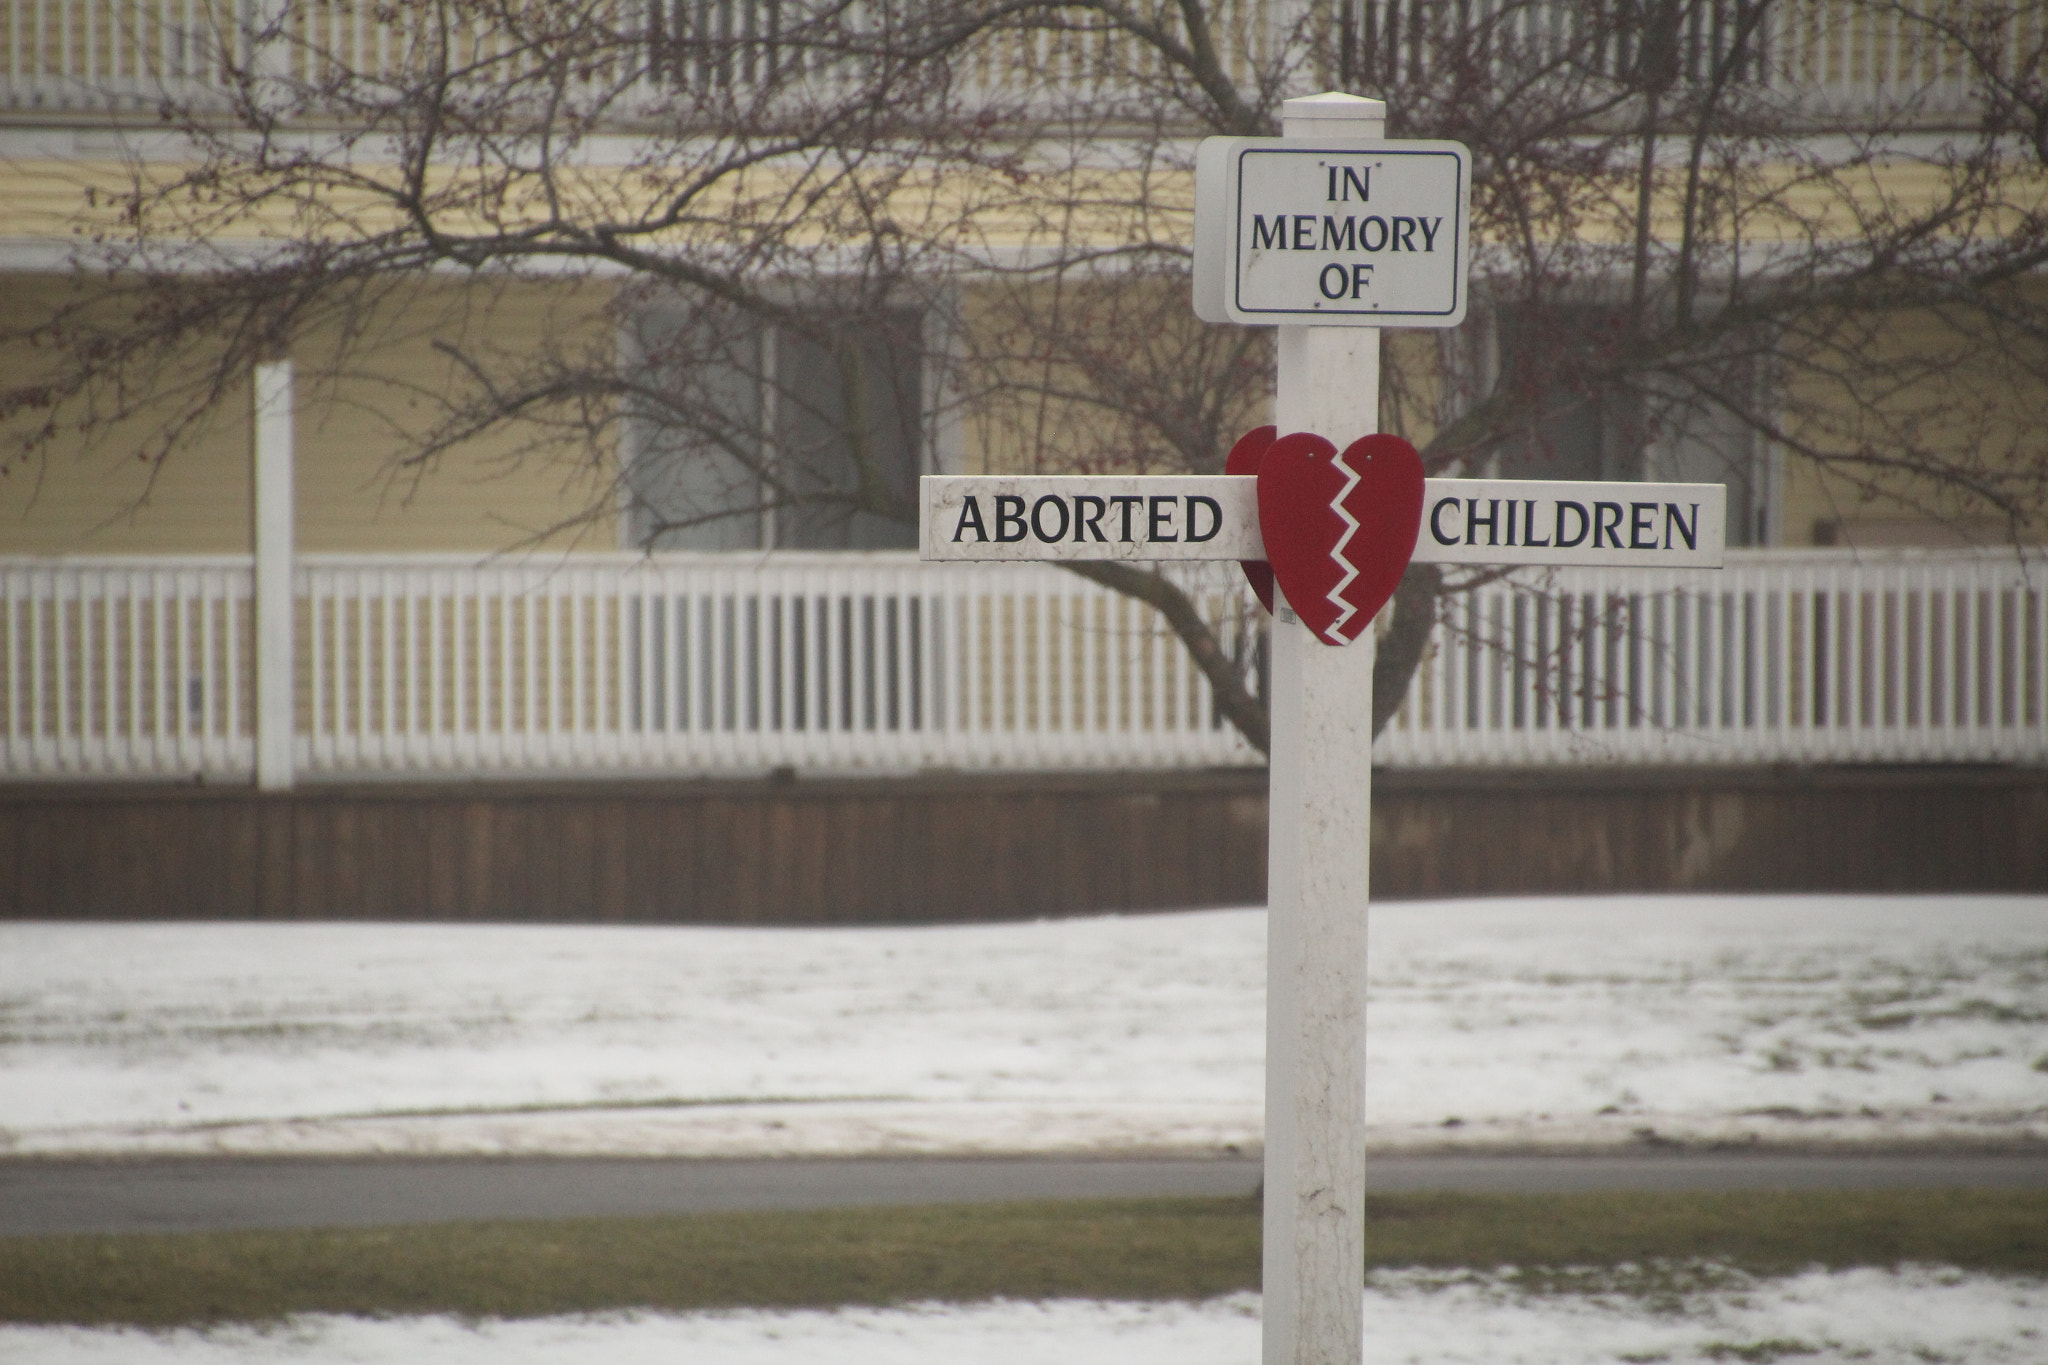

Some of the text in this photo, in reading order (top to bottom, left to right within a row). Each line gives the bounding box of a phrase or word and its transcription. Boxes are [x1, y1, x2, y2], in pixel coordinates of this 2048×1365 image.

[1326, 165, 1372, 202] IN
[1250, 214, 1444, 253] MEMORY
[1318, 262, 1375, 300] OF
[951, 494, 1701, 551] ABORTED CHILDREN
